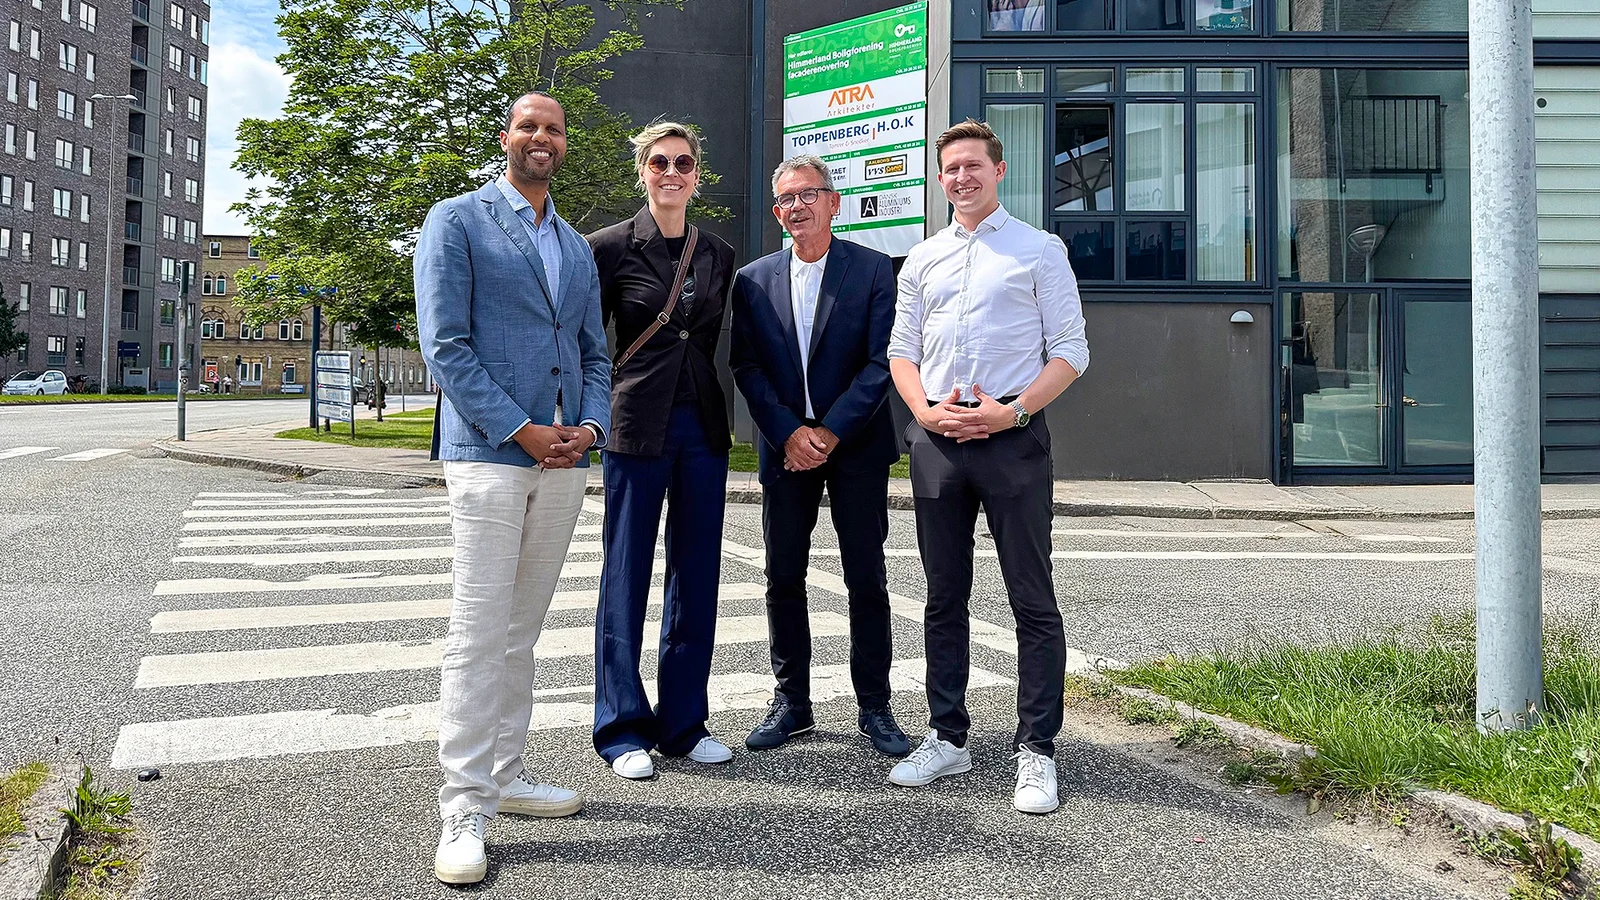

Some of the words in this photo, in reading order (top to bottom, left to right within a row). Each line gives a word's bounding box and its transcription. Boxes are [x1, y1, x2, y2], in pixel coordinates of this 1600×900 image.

[787, 51, 832, 70] Himmerland
[832, 41, 884, 60] Boligforening
[787, 59, 850, 80] facaderenovering
[827, 84, 875, 108] ATRA
[826, 102, 876, 118] Arkitekter
[791, 123, 870, 148] TOPPENBERG
[877, 115, 914, 133] H.O.K
[867, 166, 885, 176] VVS
[878, 206, 904, 217] INDUSTRI
